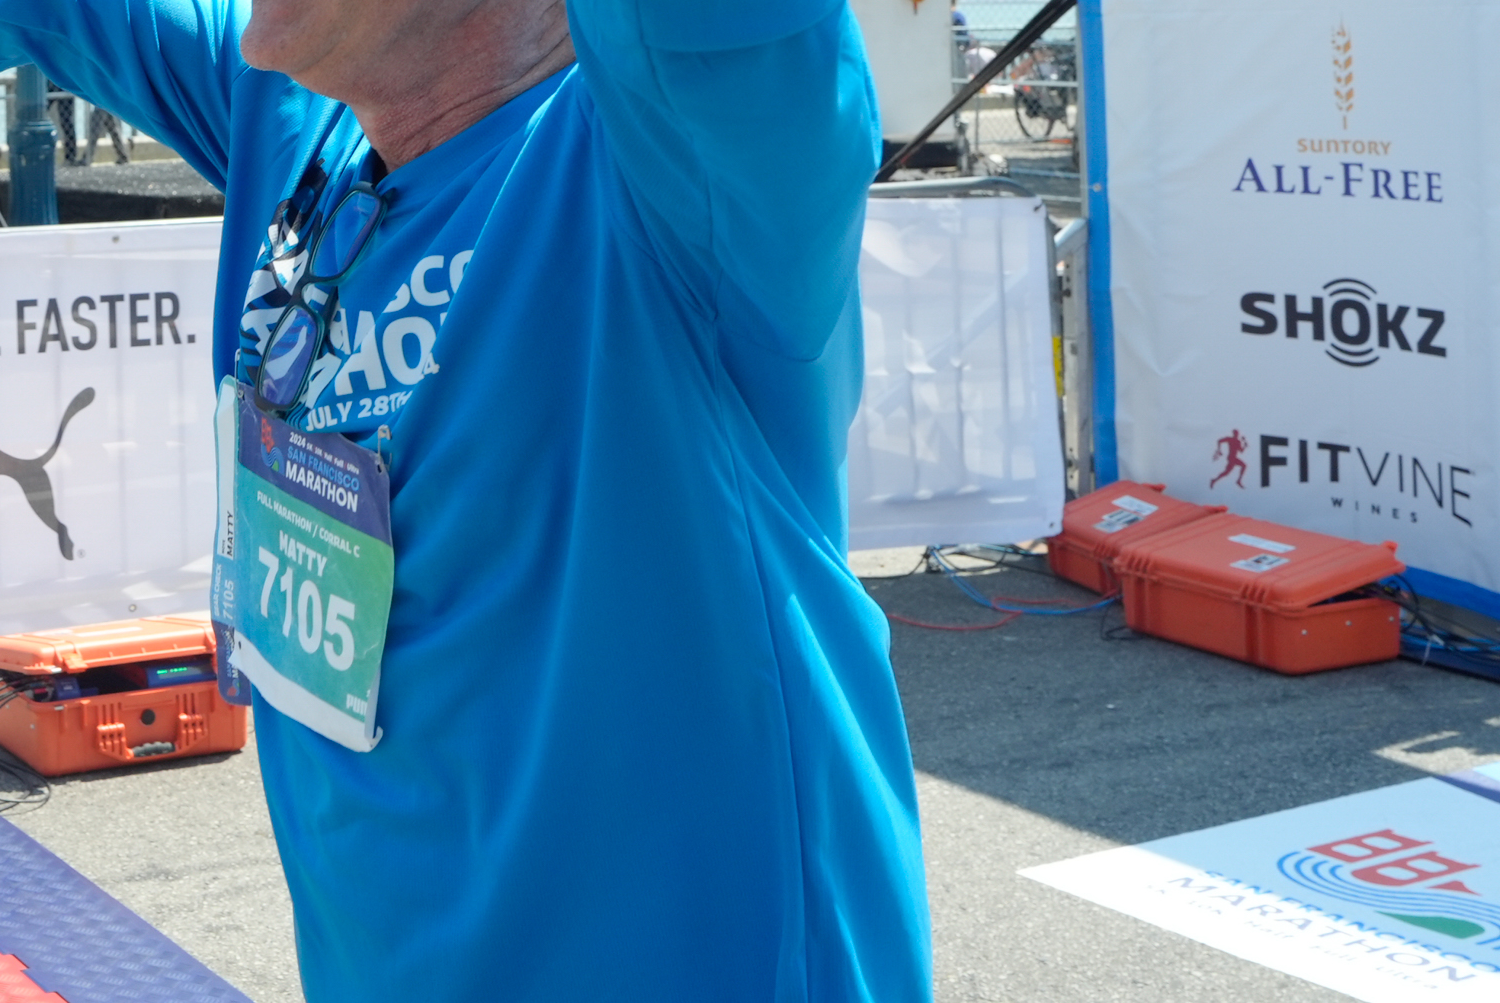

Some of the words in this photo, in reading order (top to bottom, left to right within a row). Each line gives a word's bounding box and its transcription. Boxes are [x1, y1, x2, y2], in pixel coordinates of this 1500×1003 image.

[16, 291, 198, 355] FASTER.
[1239, 292, 1447, 358] SHOKZ
[289, 431, 306, 448] 2024
[306, 401, 353, 431] JULY
[285, 460, 359, 513] MARATHON
[287, 446, 306, 465] SAN
[308, 455, 360, 491] FRANCISCO
[1259, 434, 1474, 527] FITVINE
[257, 490, 273, 509] FULL
[273, 500, 312, 533] MARATHON
[319, 527, 352, 554] CORRAL
[353, 545, 360, 558] C
[1331, 497, 1418, 524] WINES
[226, 511, 235, 560] MATTY
[279, 529, 328, 577] MATTY
[214, 563, 222, 592] CHECK
[223, 579, 235, 621] 7105
[258, 545, 356, 672] 7105
[1167, 877, 1476, 982] MARATHON
